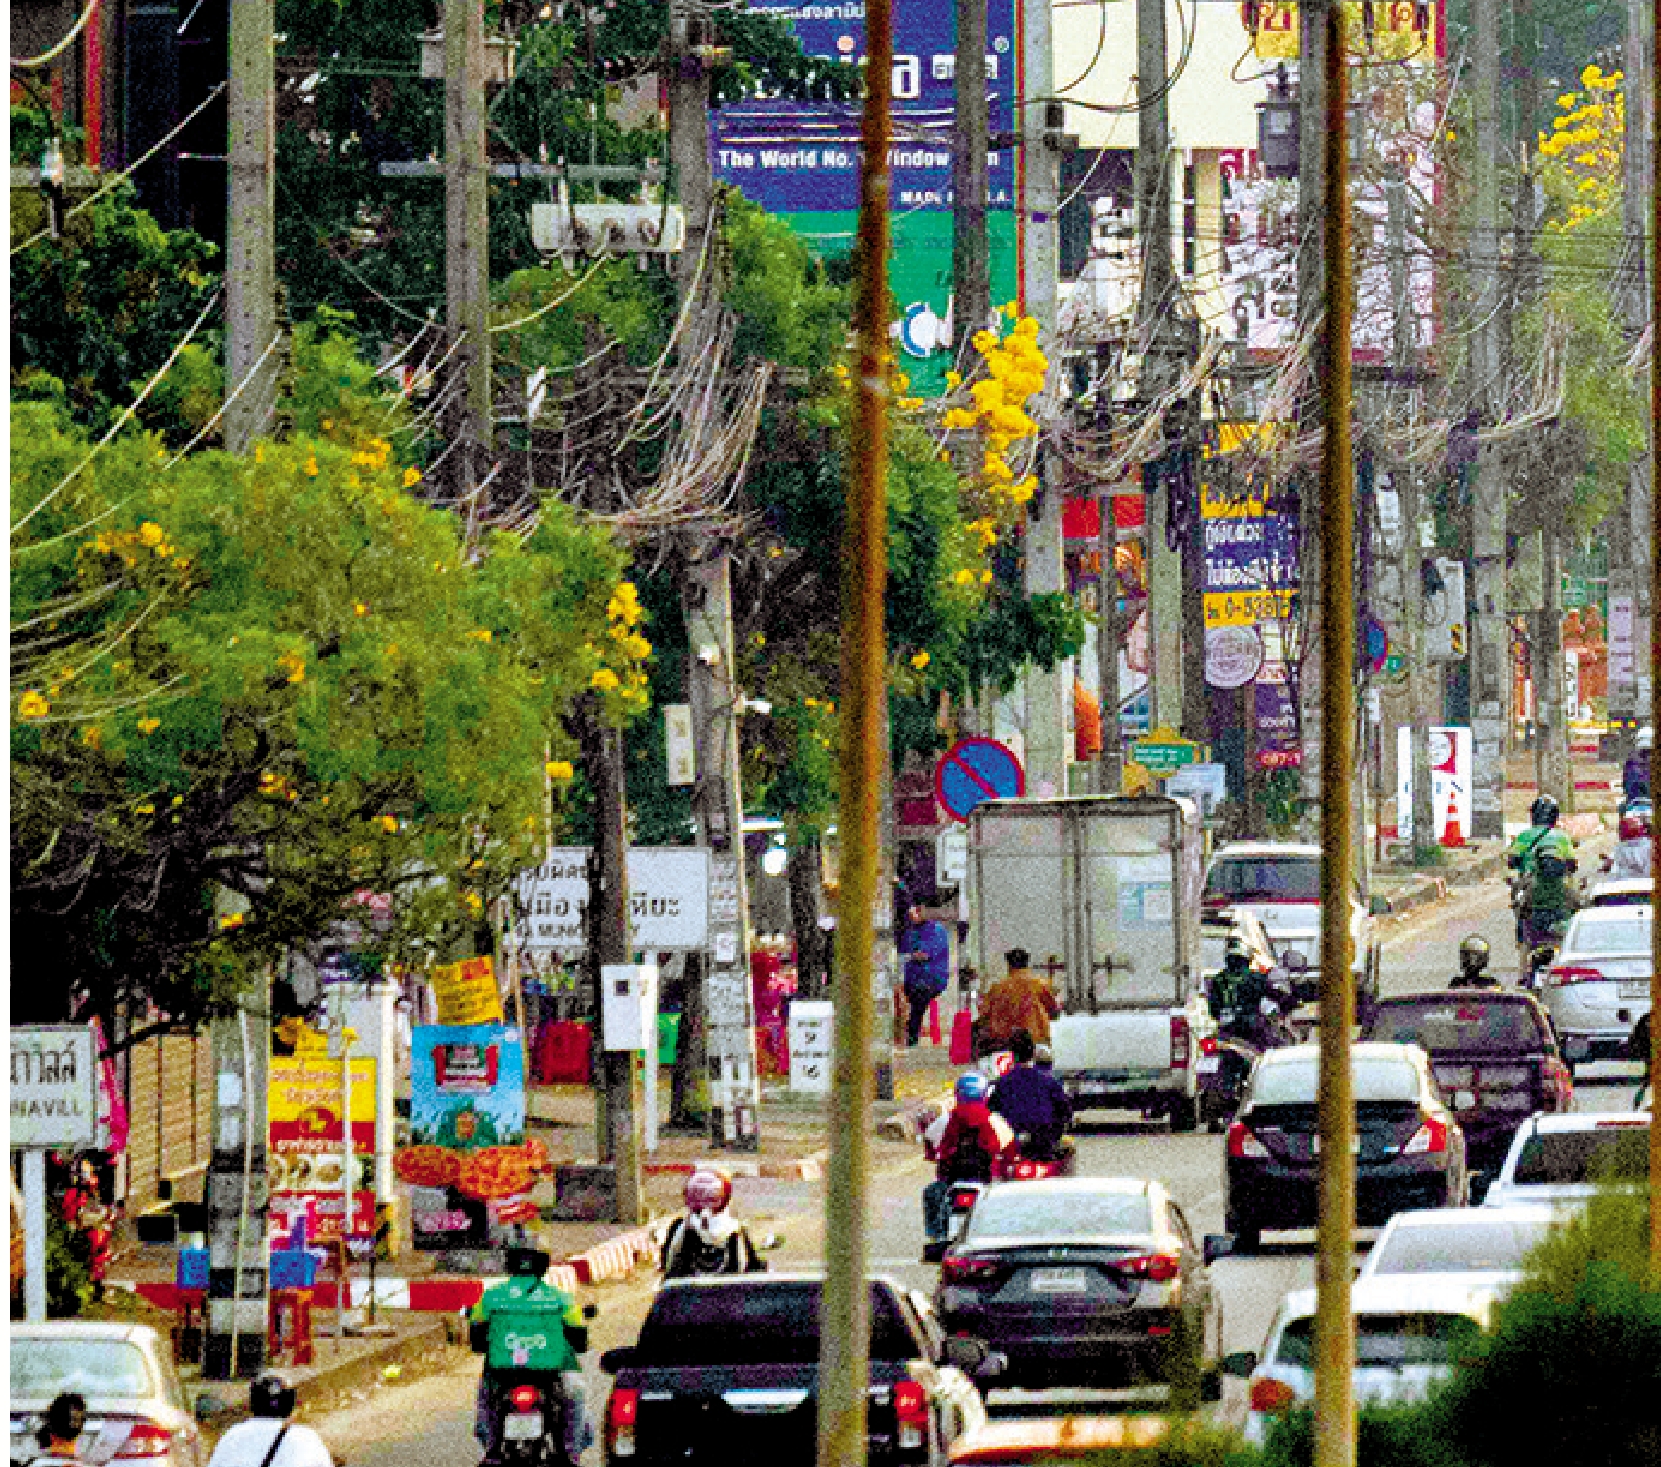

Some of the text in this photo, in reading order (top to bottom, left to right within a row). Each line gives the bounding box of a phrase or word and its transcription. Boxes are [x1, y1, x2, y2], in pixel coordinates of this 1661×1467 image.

[719, 150, 754, 168] The
[761, 150, 816, 168] World
[822, 150, 853, 168] No.
